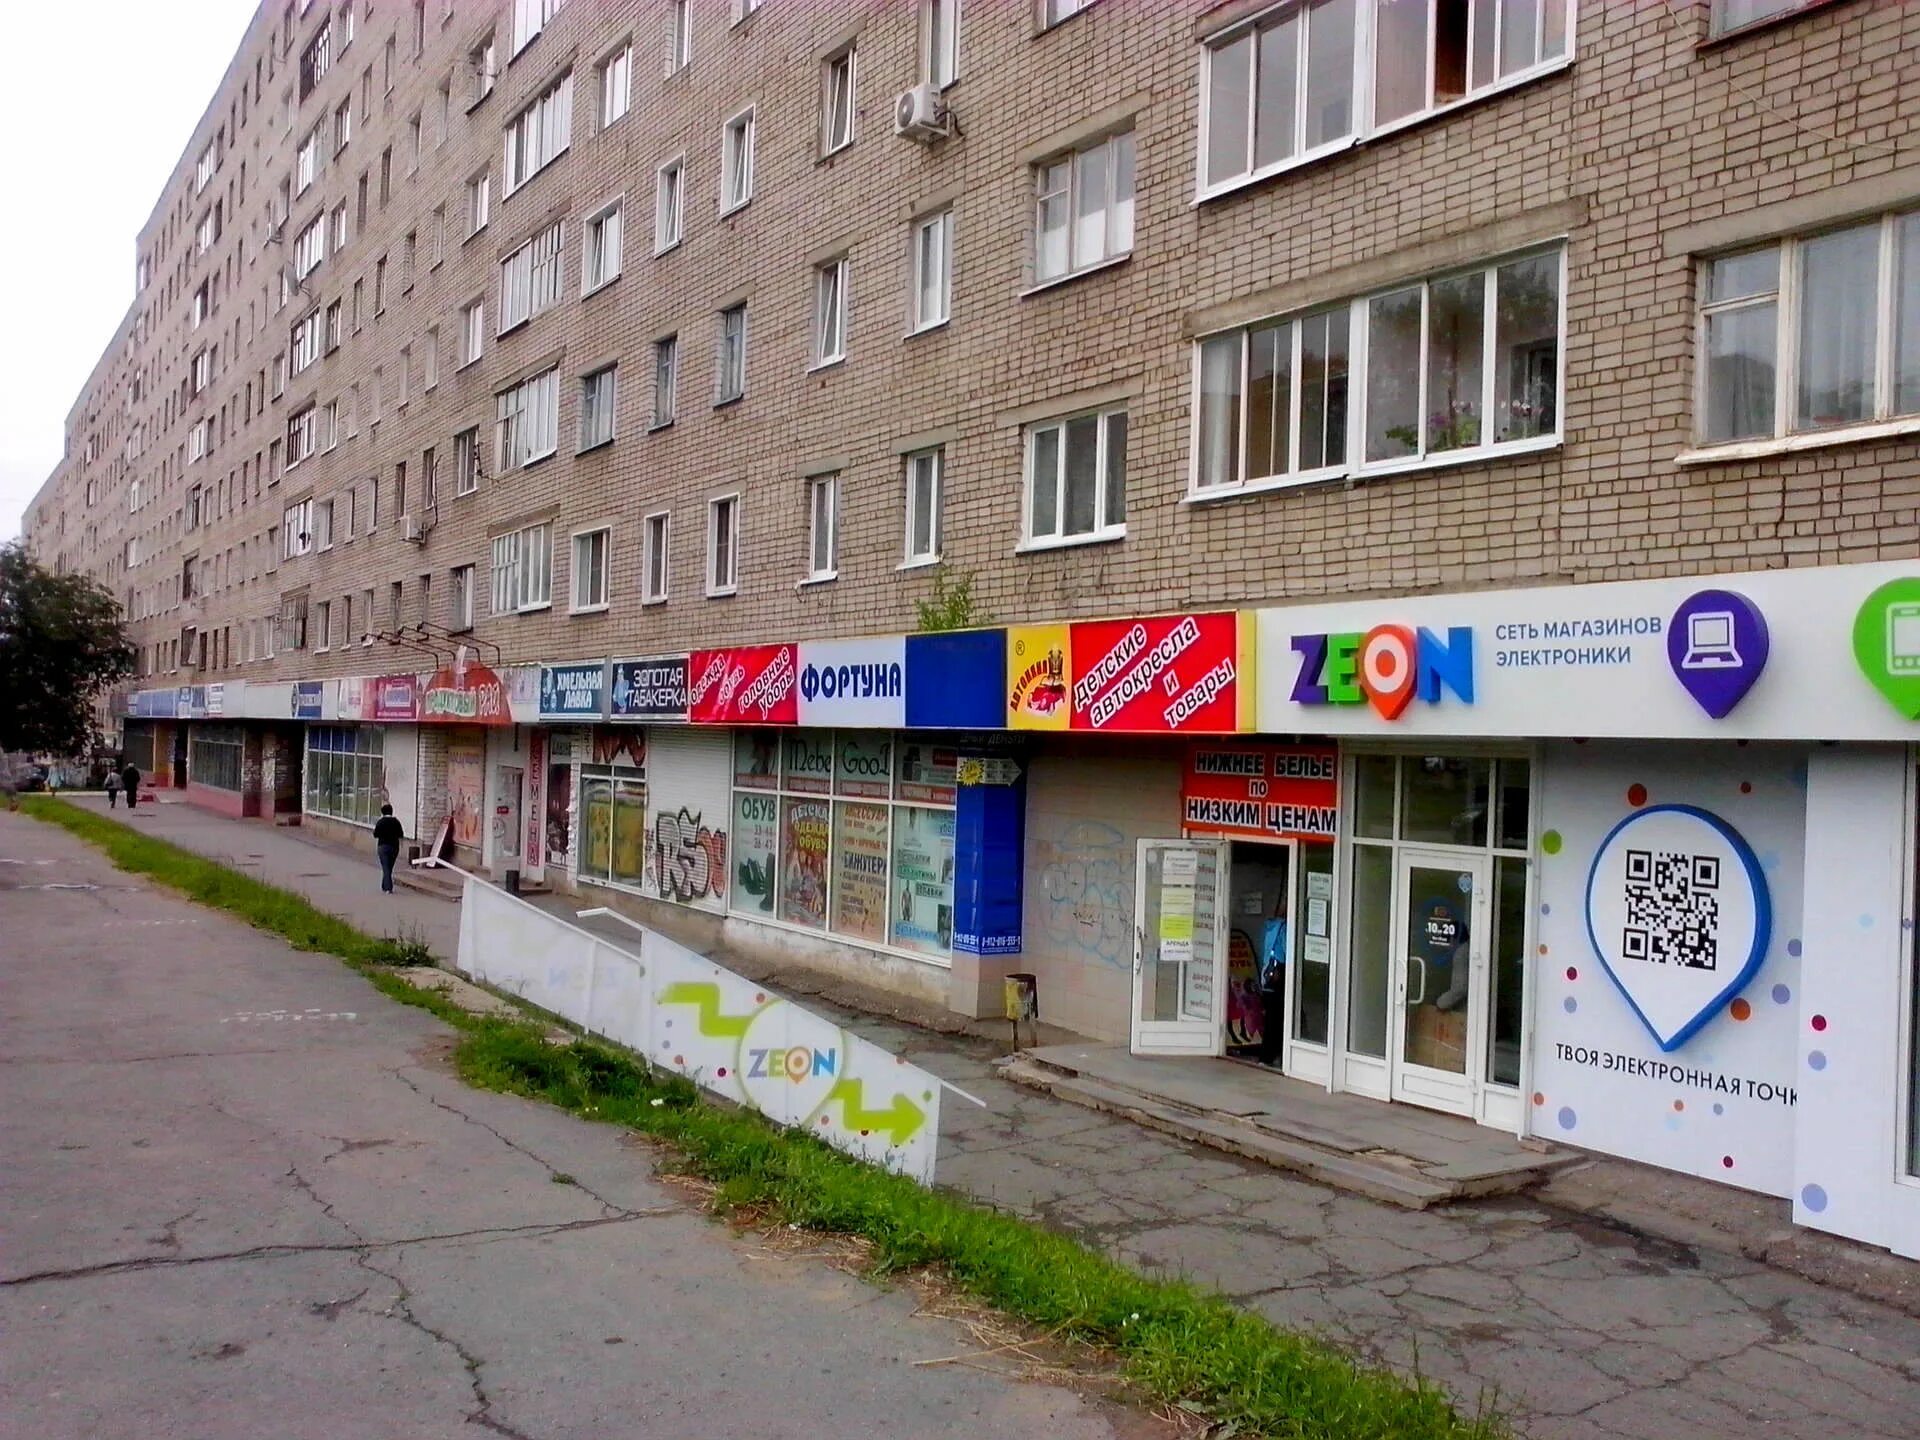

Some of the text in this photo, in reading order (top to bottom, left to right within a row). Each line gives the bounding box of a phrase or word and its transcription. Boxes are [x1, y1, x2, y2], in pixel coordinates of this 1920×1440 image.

[1495, 617, 1662, 641] СЕТЬ МАГАЗИНОВ
[1074, 624, 1147, 713] детские
[1090, 616, 1200, 728] автокресла
[1290, 624, 1475, 720] ZEON
[1496, 646, 1631, 667] ЭЛЕКТРОНИКИ
[557, 670, 603, 691] ХМЕЛЬНАЯ
[633, 668, 683, 687] ЗОЛОТАЯ
[690, 654, 726, 705] одежда
[738, 647, 790, 713] головные
[758, 665, 795, 720] уборы
[801, 663, 901, 702] ФОРТУНА
[1163, 670, 1180, 696] и
[1164, 657, 1236, 728] товары
[564, 690, 592, 709] ЛАВКА
[628, 688, 688, 707] ТАБАКЕРКА
[1195, 751, 1334, 779] НИЖНЕЕ БЕЛЬЕ
[1249, 779, 1268, 797] ПО
[1186, 796, 1336, 834] НИЗКИМ ЦЕНАМ
[1427, 922, 1455, 935] 10 20
[747, 1046, 835, 1084] ZEON
[1556, 1043, 1598, 1066] ТВОЯ
[1603, 1052, 1741, 1096] ЭЛЕКТРОННАЯ
